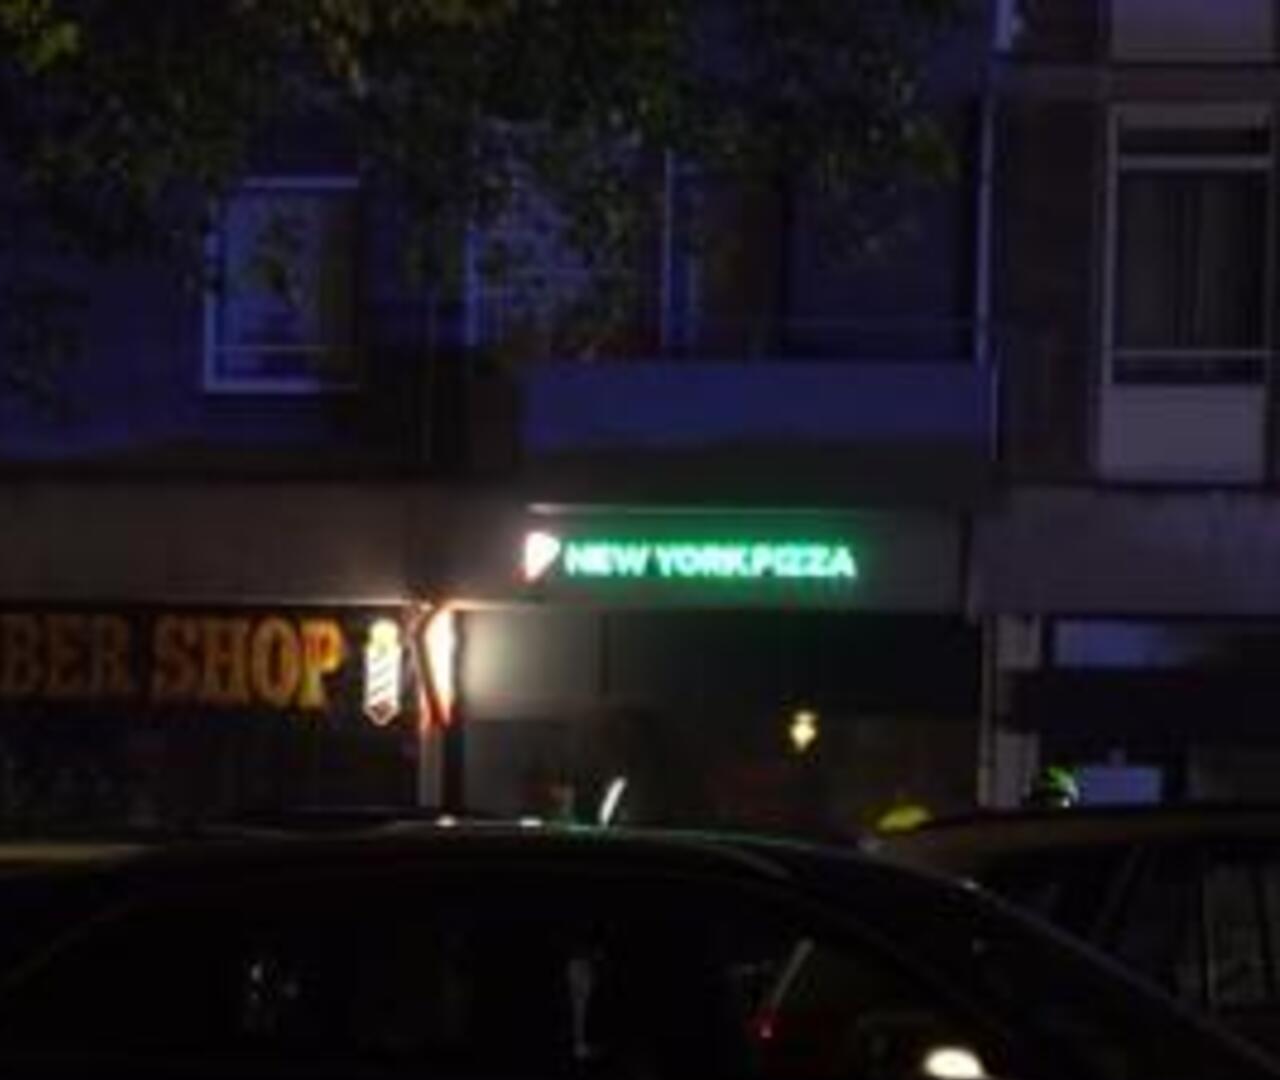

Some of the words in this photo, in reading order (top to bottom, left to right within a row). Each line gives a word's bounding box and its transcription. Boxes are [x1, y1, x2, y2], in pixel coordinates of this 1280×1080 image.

[564, 542, 647, 577] NEW
[653, 542, 749, 577] YORK
[750, 542, 856, 577] PIZZA
[150, 613, 348, 708] SHOP
